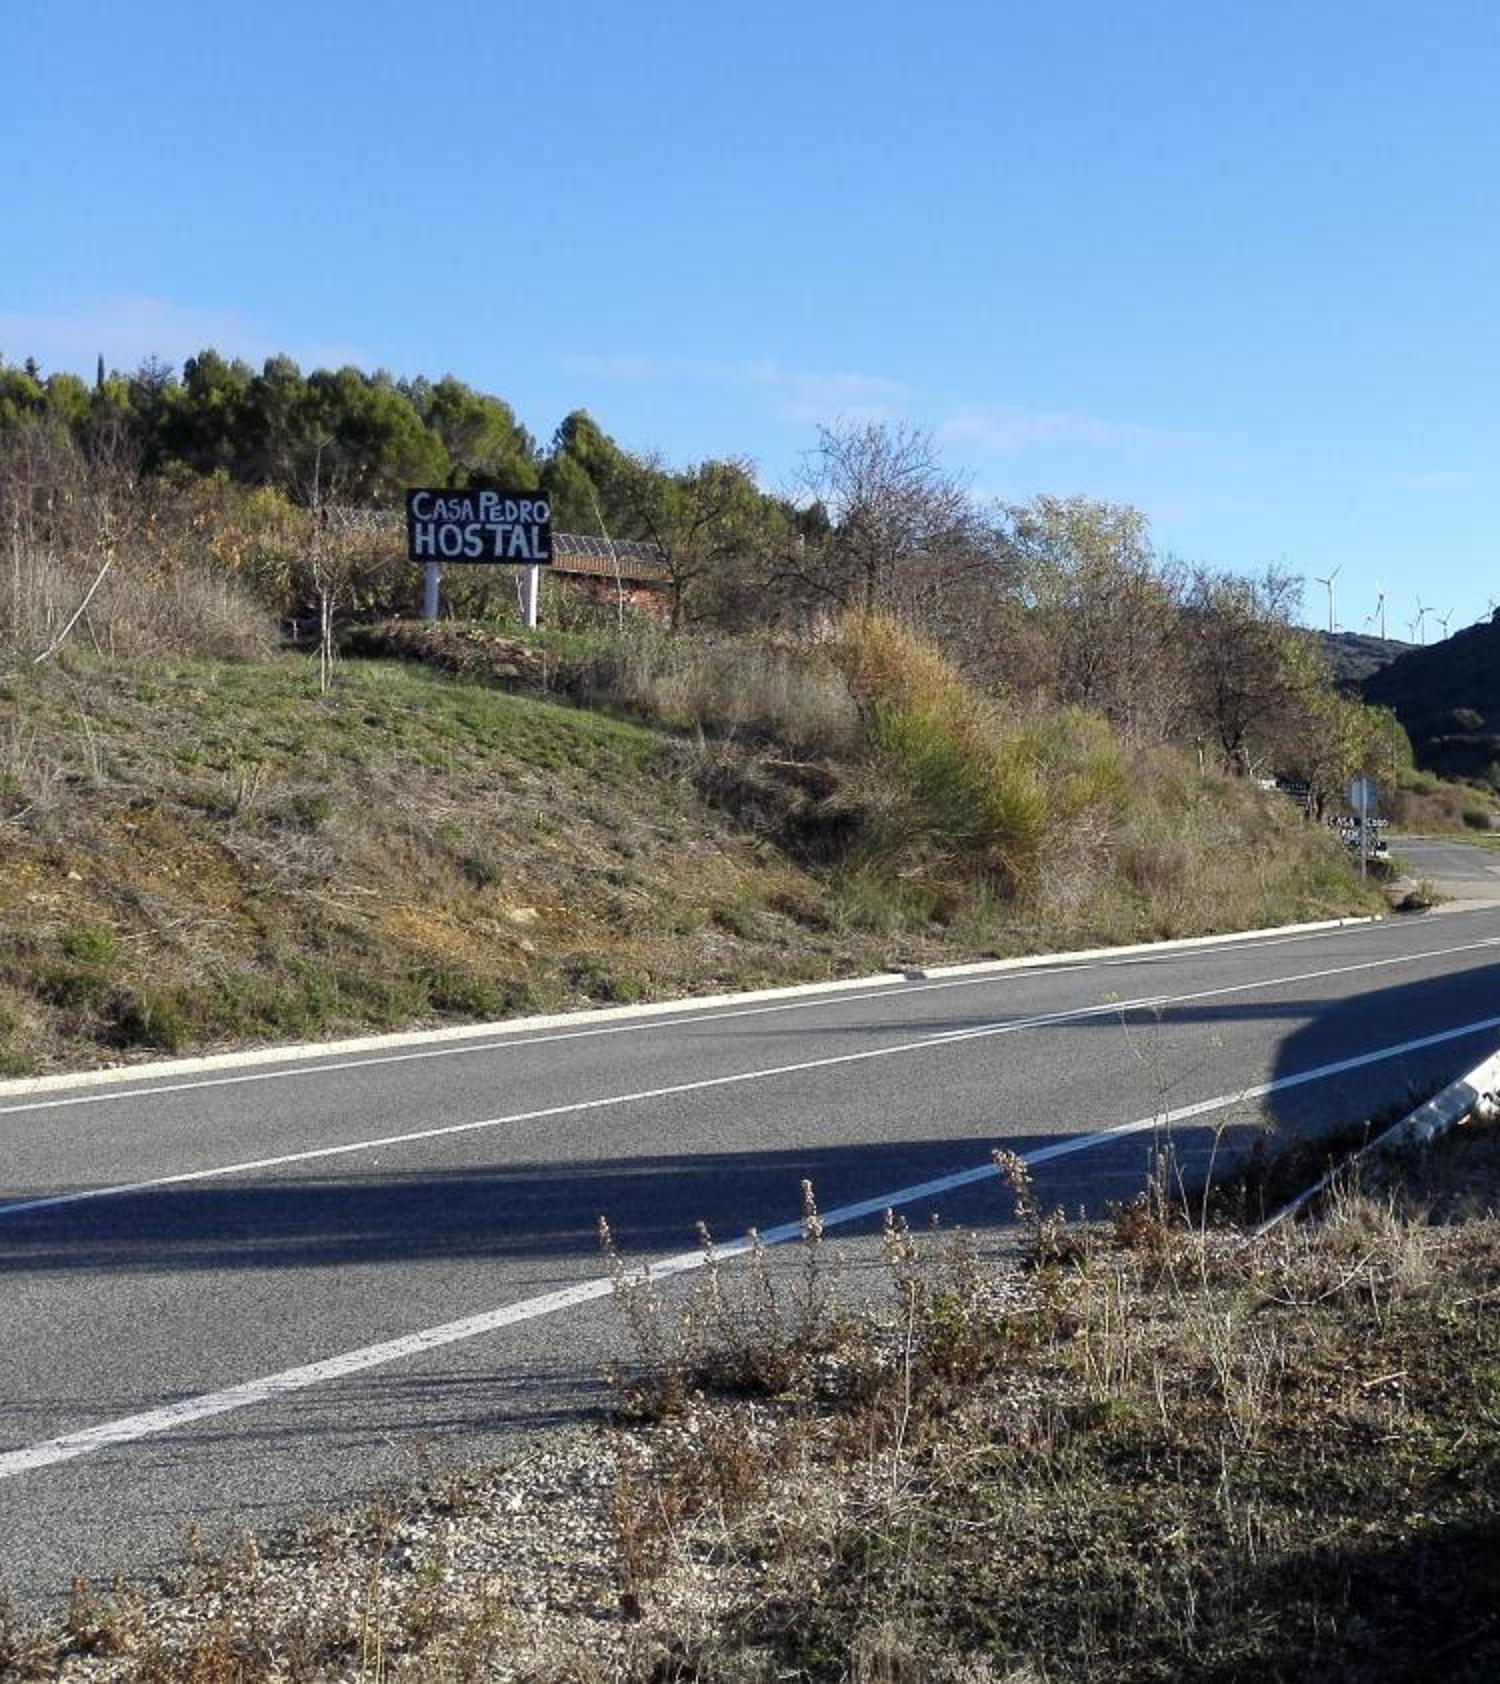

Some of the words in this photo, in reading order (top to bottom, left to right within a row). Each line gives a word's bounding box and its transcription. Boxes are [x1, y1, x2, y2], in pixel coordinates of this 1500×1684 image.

[412, 491, 474, 521] CASA
[480, 491, 551, 523] PEDRO
[415, 522, 549, 559] HOSTAL
